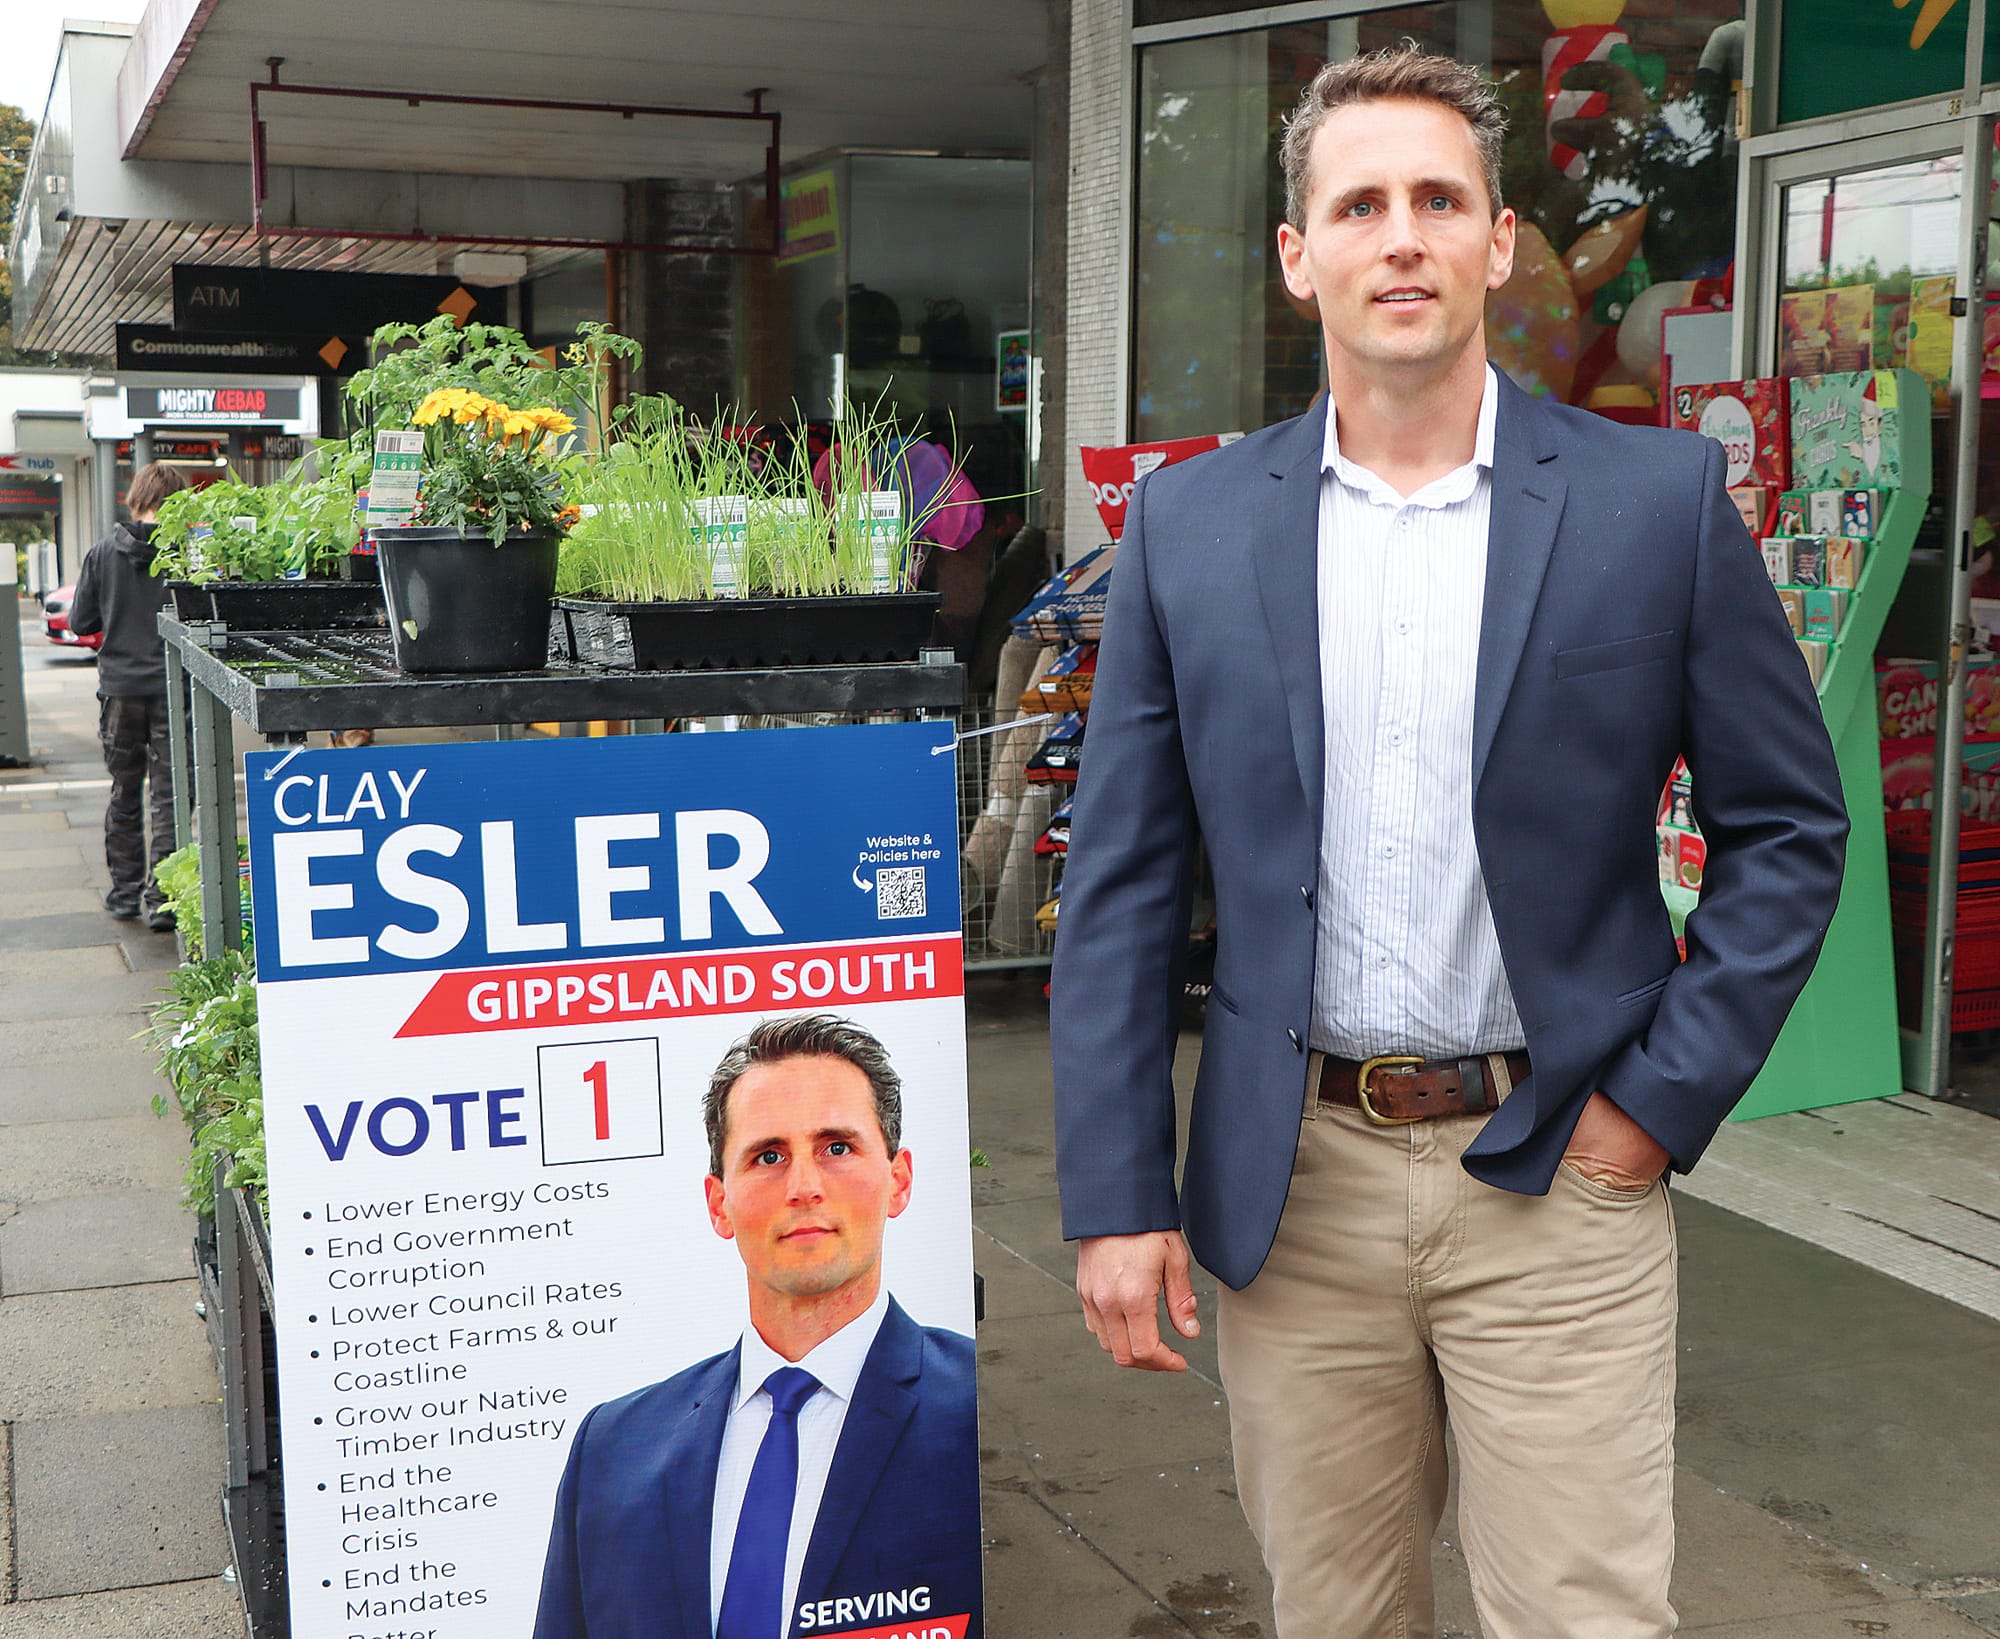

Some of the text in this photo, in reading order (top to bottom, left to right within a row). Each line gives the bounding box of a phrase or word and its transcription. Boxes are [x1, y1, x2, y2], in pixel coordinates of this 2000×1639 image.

[190, 286, 240, 307] ATM
[158, 388, 267, 412] MIGHTY KEBAB
[265, 436, 303, 454] MIGHTY
[27, 457, 55, 469] hub
[273, 768, 427, 826] CLAY
[859, 848, 941, 864] Policies here
[866, 833, 932, 848] Website &
[273, 808, 784, 968] ESLER
[466, 950, 936, 1023] GIPPSLAND SOUTH
[303, 1060, 610, 1162] VOTE 1
[325, 1180, 610, 1223] Lower Energy Costs
[327, 1217, 575, 1258] End Government
[328, 1257, 486, 1291] Corruption
[330, 1278, 623, 1326] Lower Council Rates
[332, 1314, 619, 1361] Protect Farms & our
[334, 1362, 468, 1393] Coastline
[335, 1385, 568, 1428] Grow our Native
[336, 1417, 567, 1459] Timber Industry
[340, 1464, 453, 1494] End the
[341, 1491, 498, 1525] Healthcare
[342, 1527, 419, 1555] Crisis
[344, 1559, 457, 1590] End the
[346, 1585, 489, 1621] Mandates
[799, 1585, 931, 1628] SERVING
